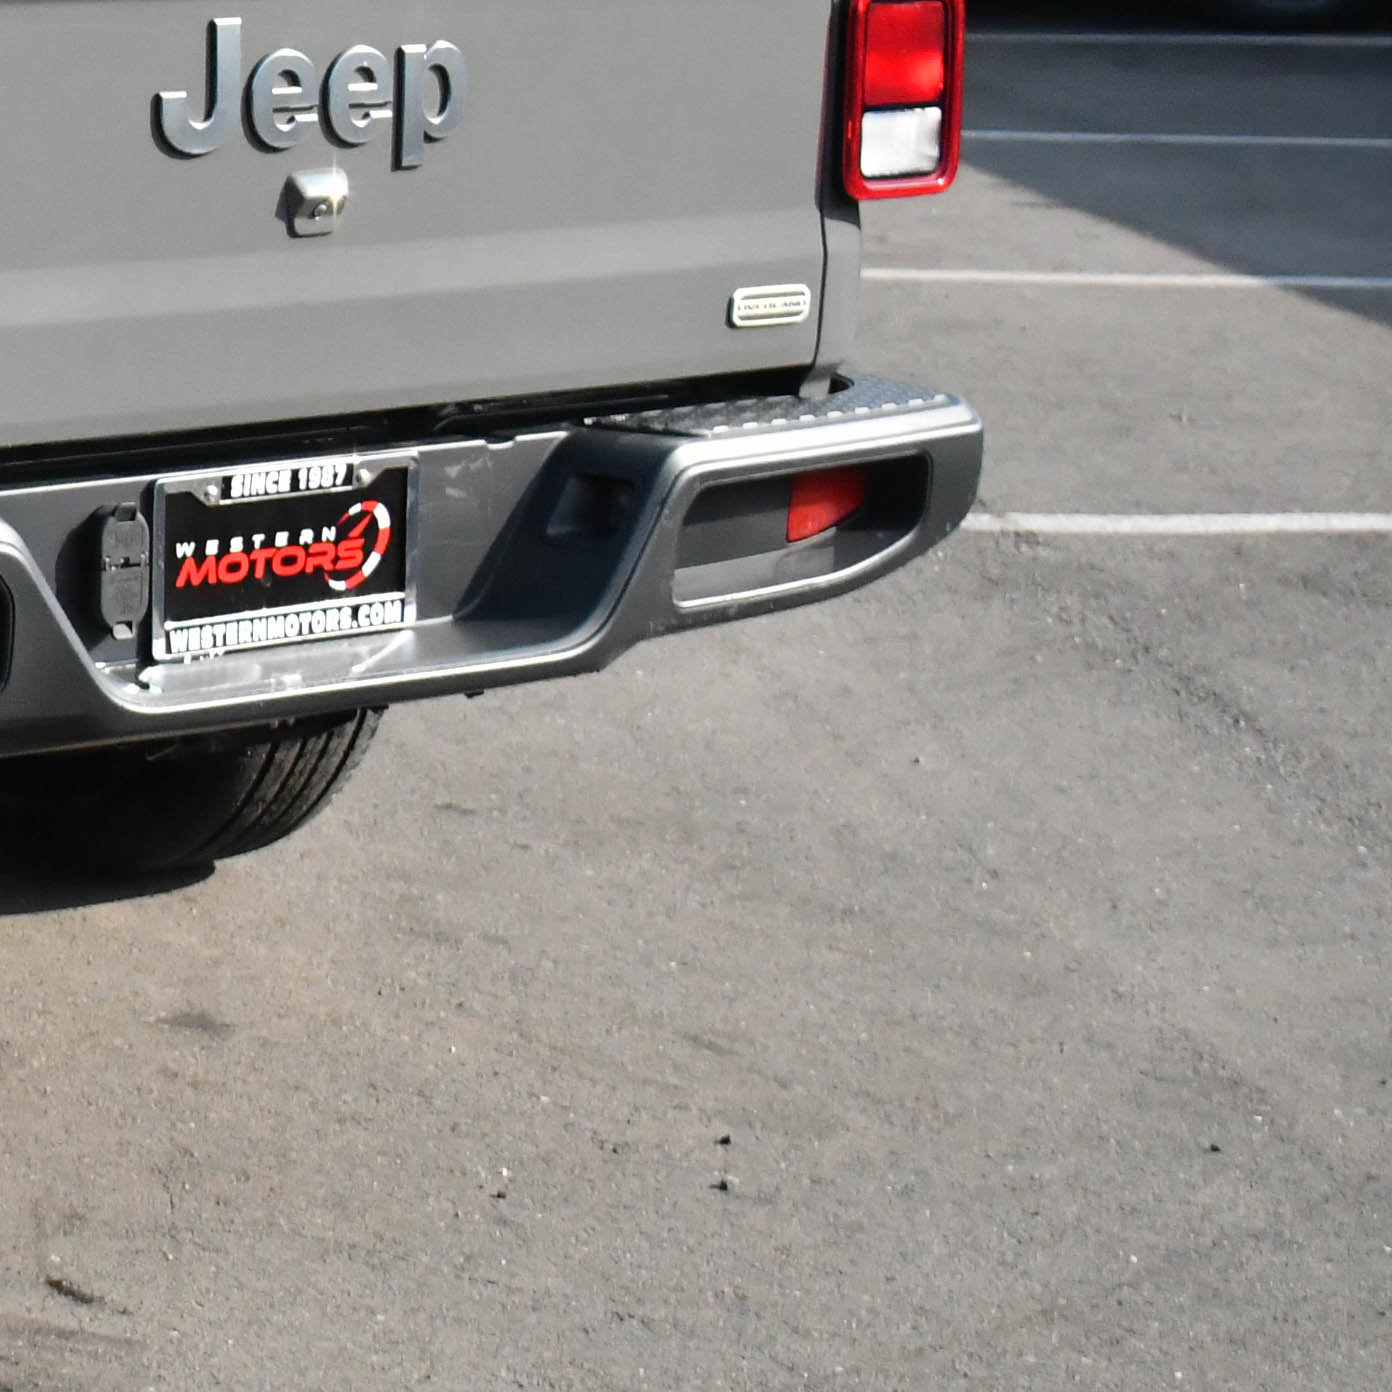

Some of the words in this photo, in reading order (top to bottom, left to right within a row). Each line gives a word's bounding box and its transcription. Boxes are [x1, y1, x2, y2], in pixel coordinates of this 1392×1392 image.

[151, 17, 466, 171] Jeep
[231, 469, 292, 498] SINCE
[298, 463, 347, 490] 1987
[175, 526, 337, 559] WESTERN
[175, 538, 366, 588] MOTORS
[169, 599, 403, 654] WESTERNMOTORS.COM
